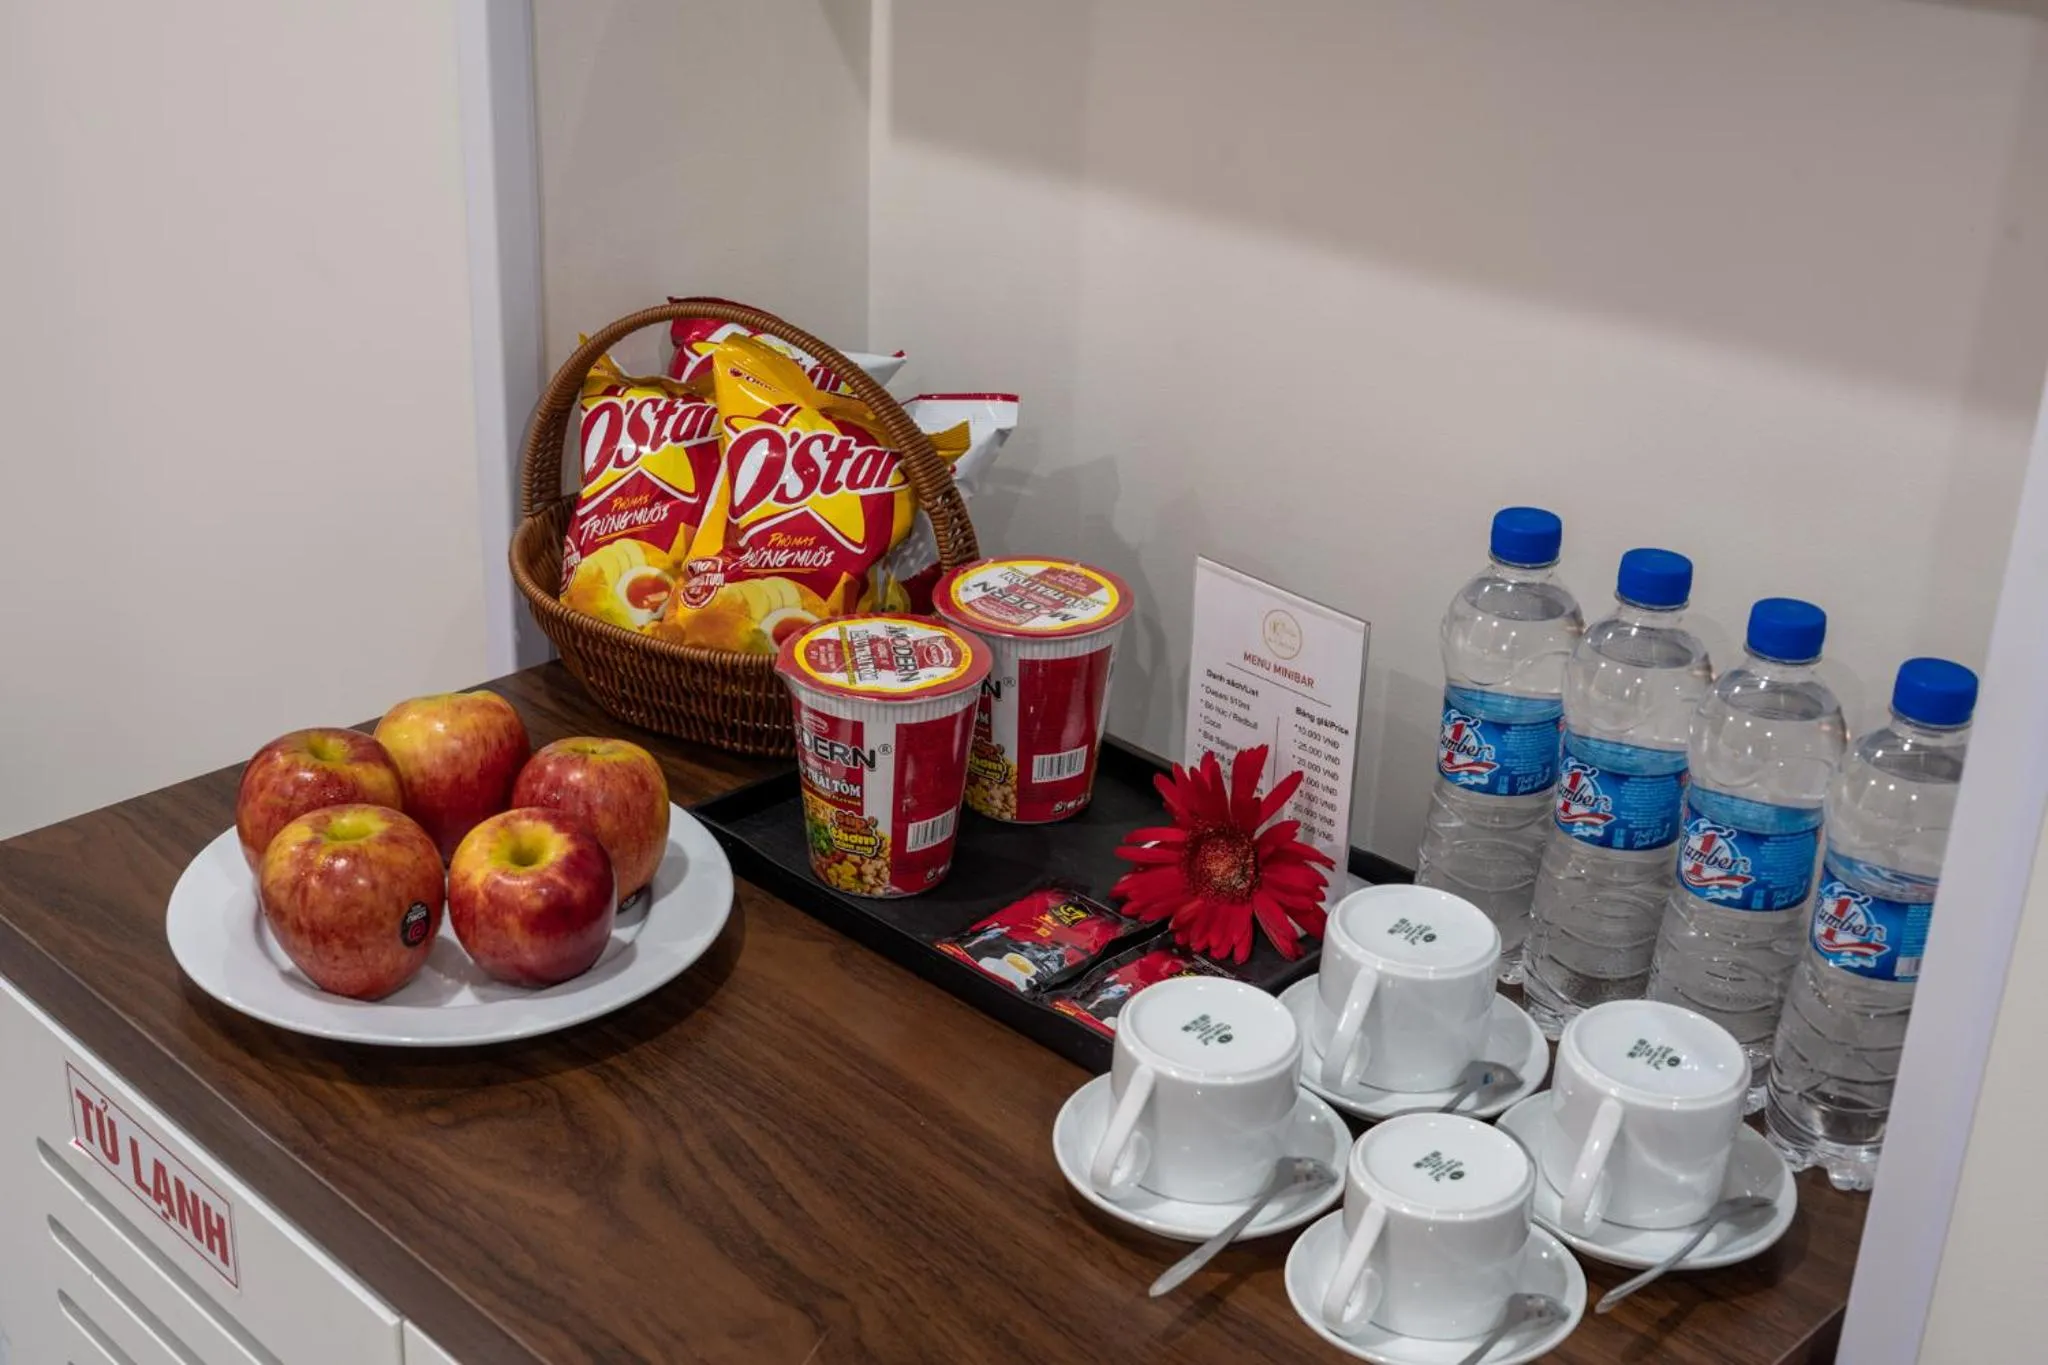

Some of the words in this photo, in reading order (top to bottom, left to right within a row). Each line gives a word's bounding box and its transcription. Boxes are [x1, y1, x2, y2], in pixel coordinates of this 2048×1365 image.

[581, 398, 718, 485] O'Star
[727, 428, 902, 520] O'Star
[884, 625, 921, 682] MODERN
[1243, 651, 1271, 671] MENU
[1273, 663, 1315, 689] MINIBAR
[75, 1087, 120, 1166] TỦ
[129, 1136, 230, 1267] LẠNH
